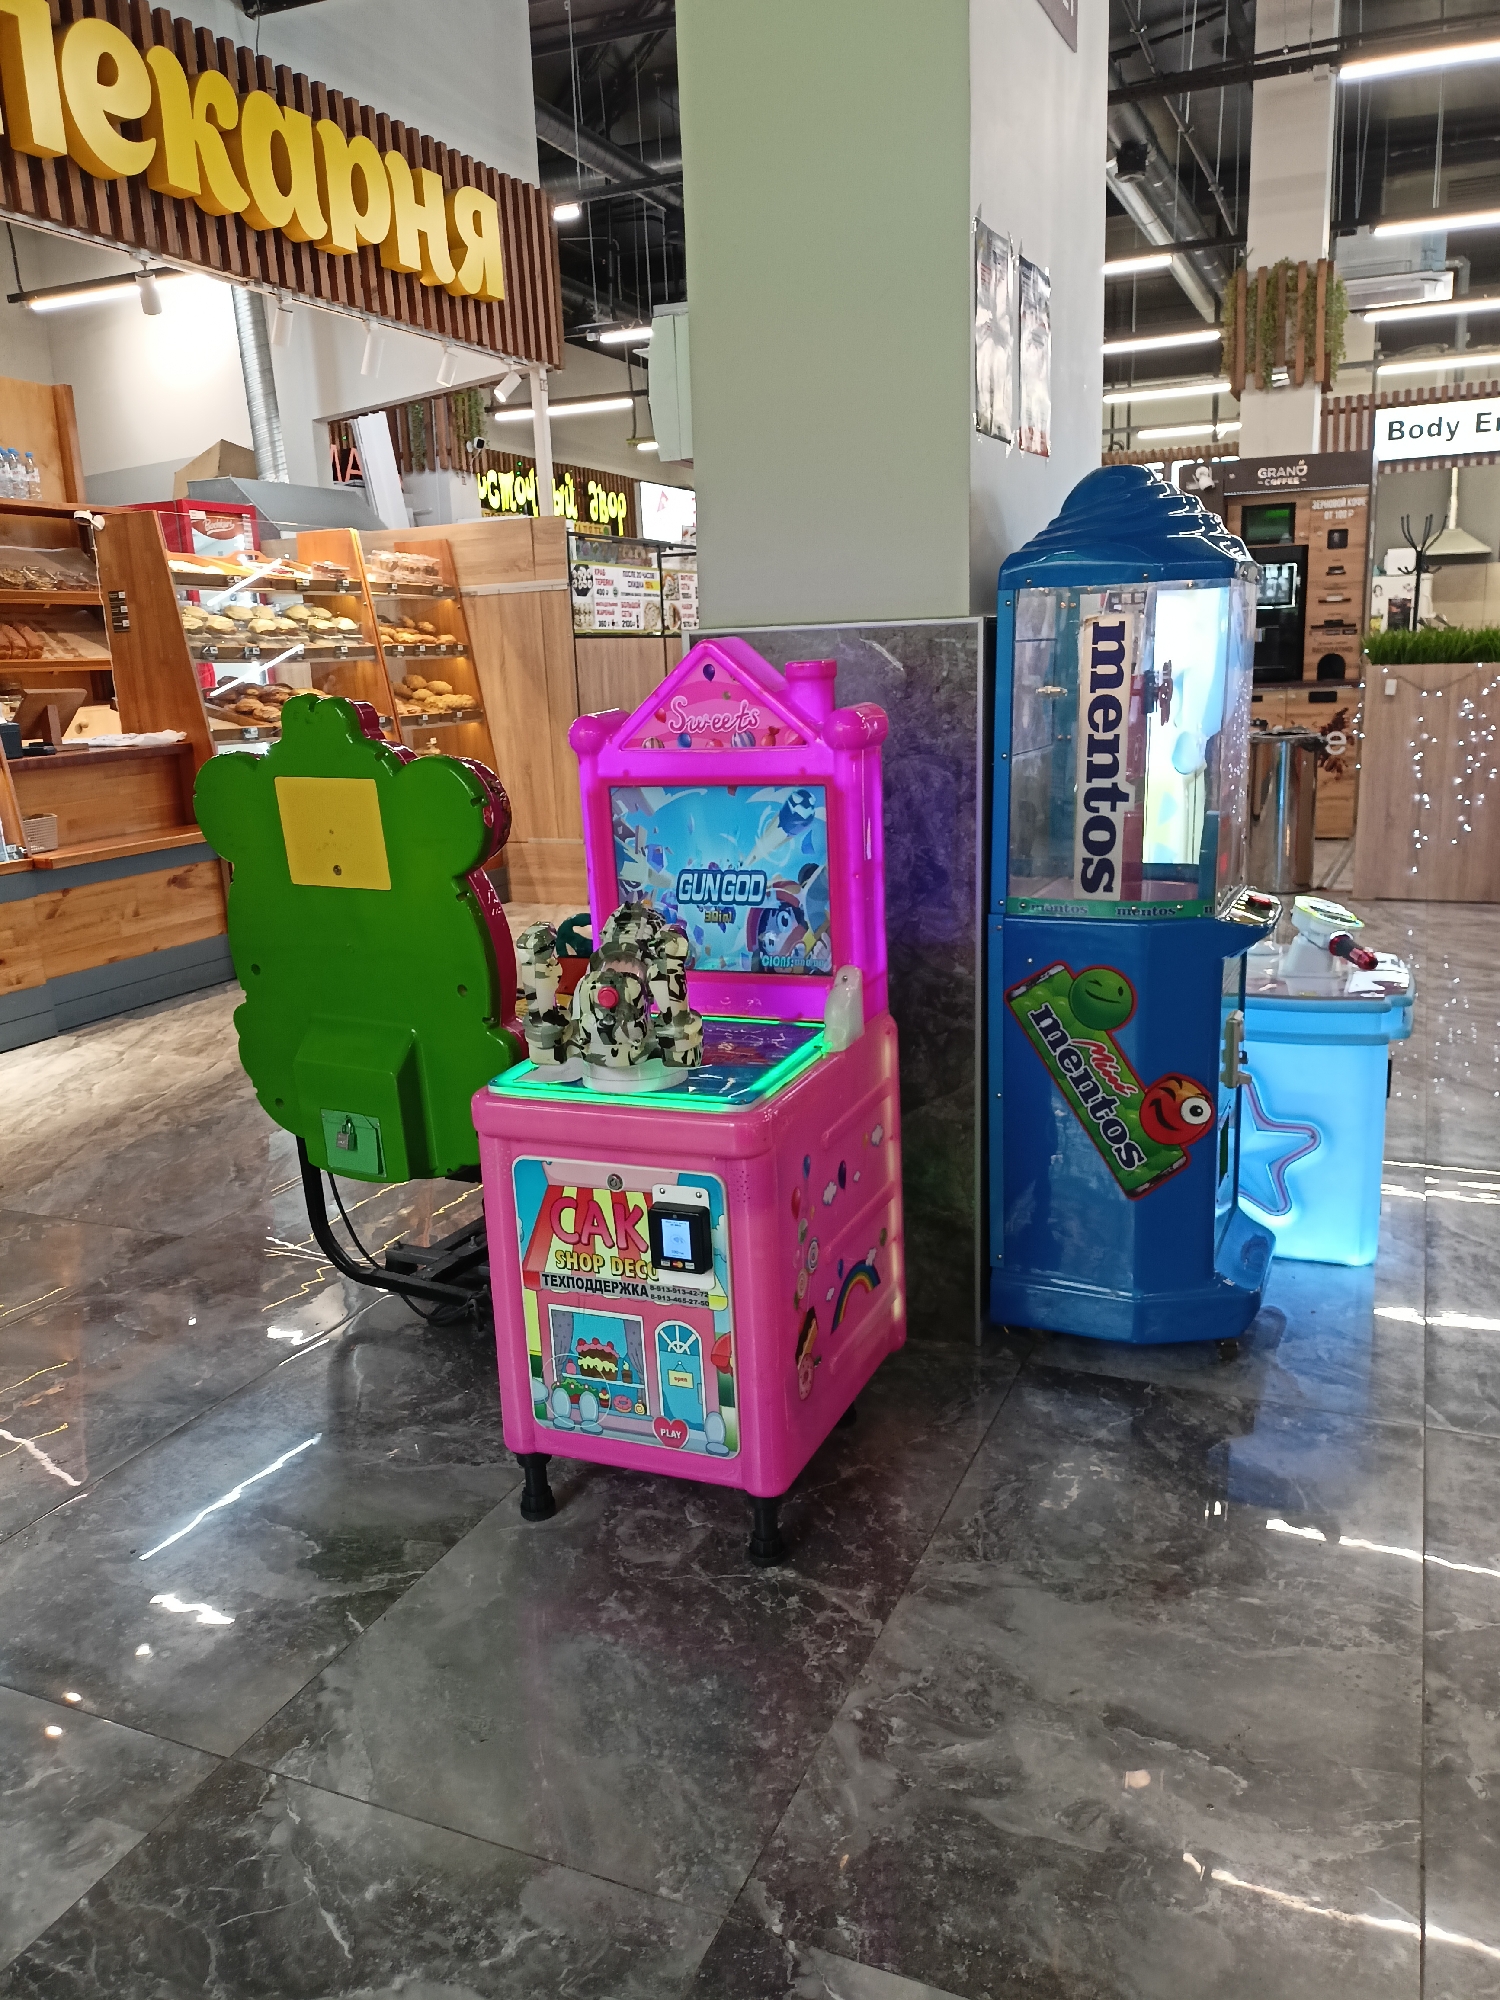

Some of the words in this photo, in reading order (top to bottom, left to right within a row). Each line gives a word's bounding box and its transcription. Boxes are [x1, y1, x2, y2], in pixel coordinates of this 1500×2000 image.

[1388, 417, 1460, 441] Body
[668, 695, 760, 734] Sweets
[1080, 620, 1130, 894] mentos
[1116, 905, 1177, 917] mentos
[1070, 1038, 1139, 1098] Mini
[1028, 1002, 1147, 1171] mentos
[550, 1196, 650, 1253] CAK
[554, 1249, 606, 1275] SHOP
[541, 1273, 650, 1299] ТЕХПОДДЕРЖКА
[660, 1428, 682, 1440] PLAY
